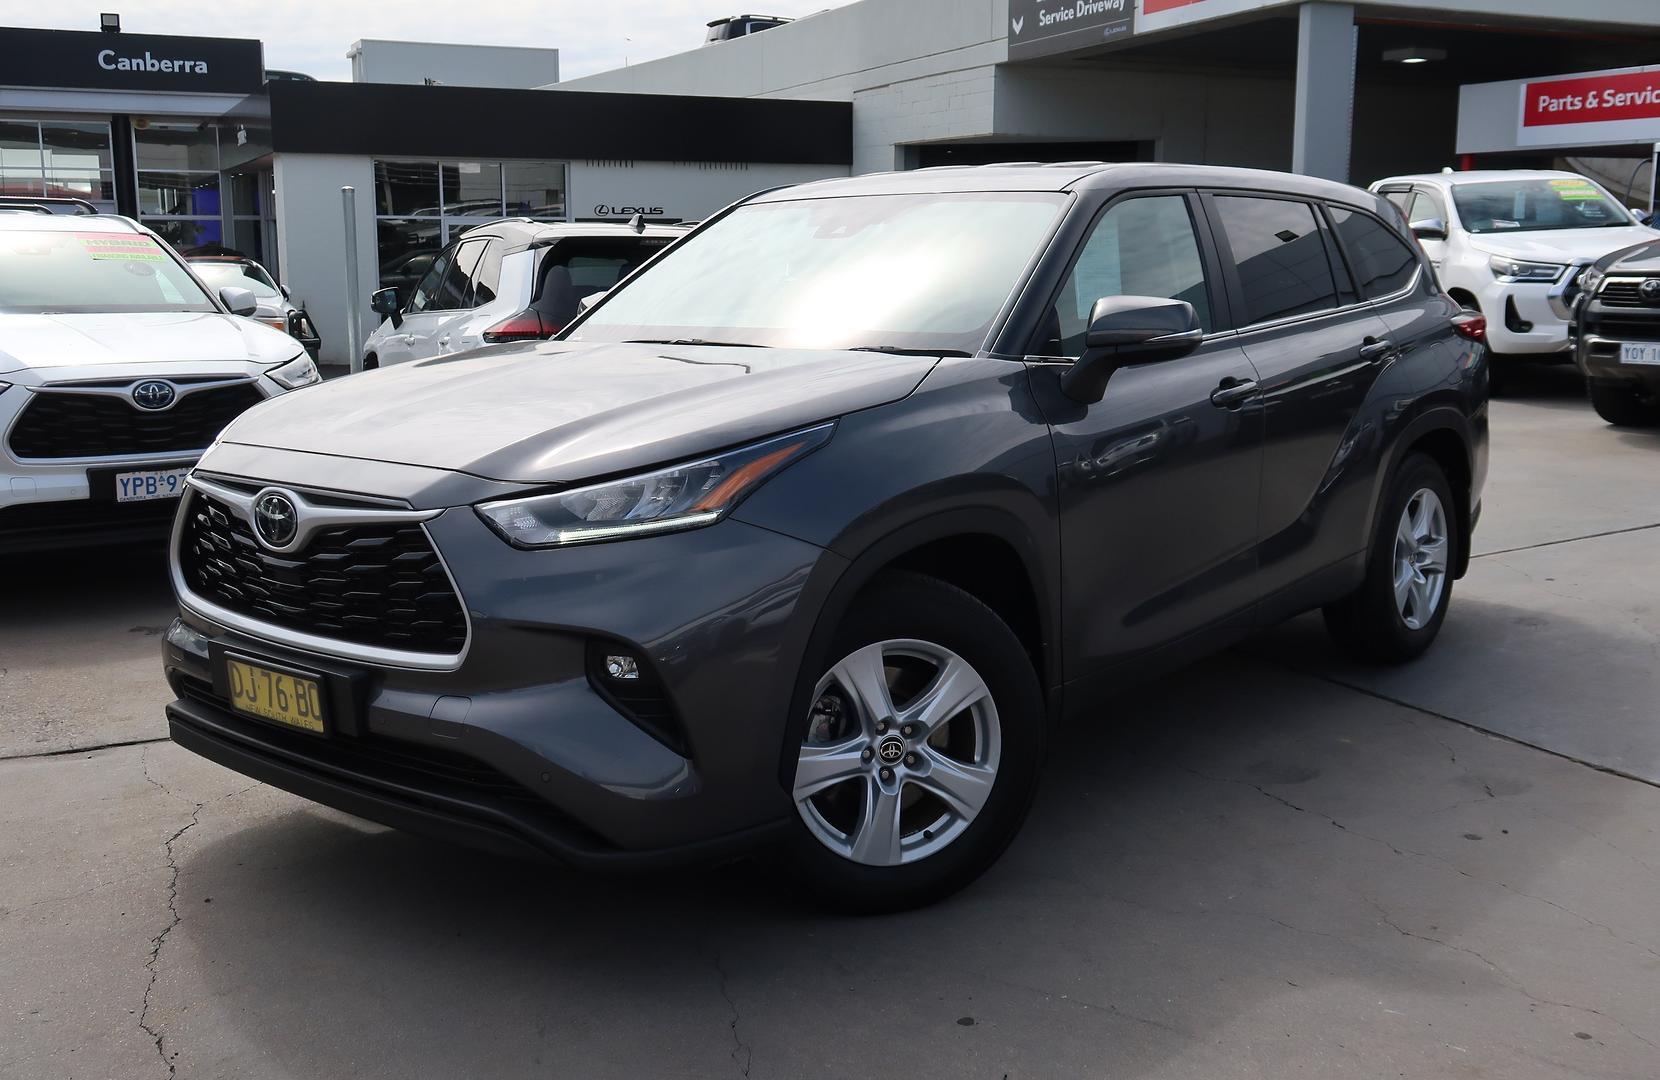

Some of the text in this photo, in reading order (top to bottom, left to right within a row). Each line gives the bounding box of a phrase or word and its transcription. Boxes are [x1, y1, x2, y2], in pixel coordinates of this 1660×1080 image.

[1039, 0, 1125, 26] Service Driveway
[98, 49, 208, 74] Canberra
[1538, 94, 1583, 112] Parts
[1585, 91, 1600, 109] &
[612, 207, 664, 215] LEXUS
